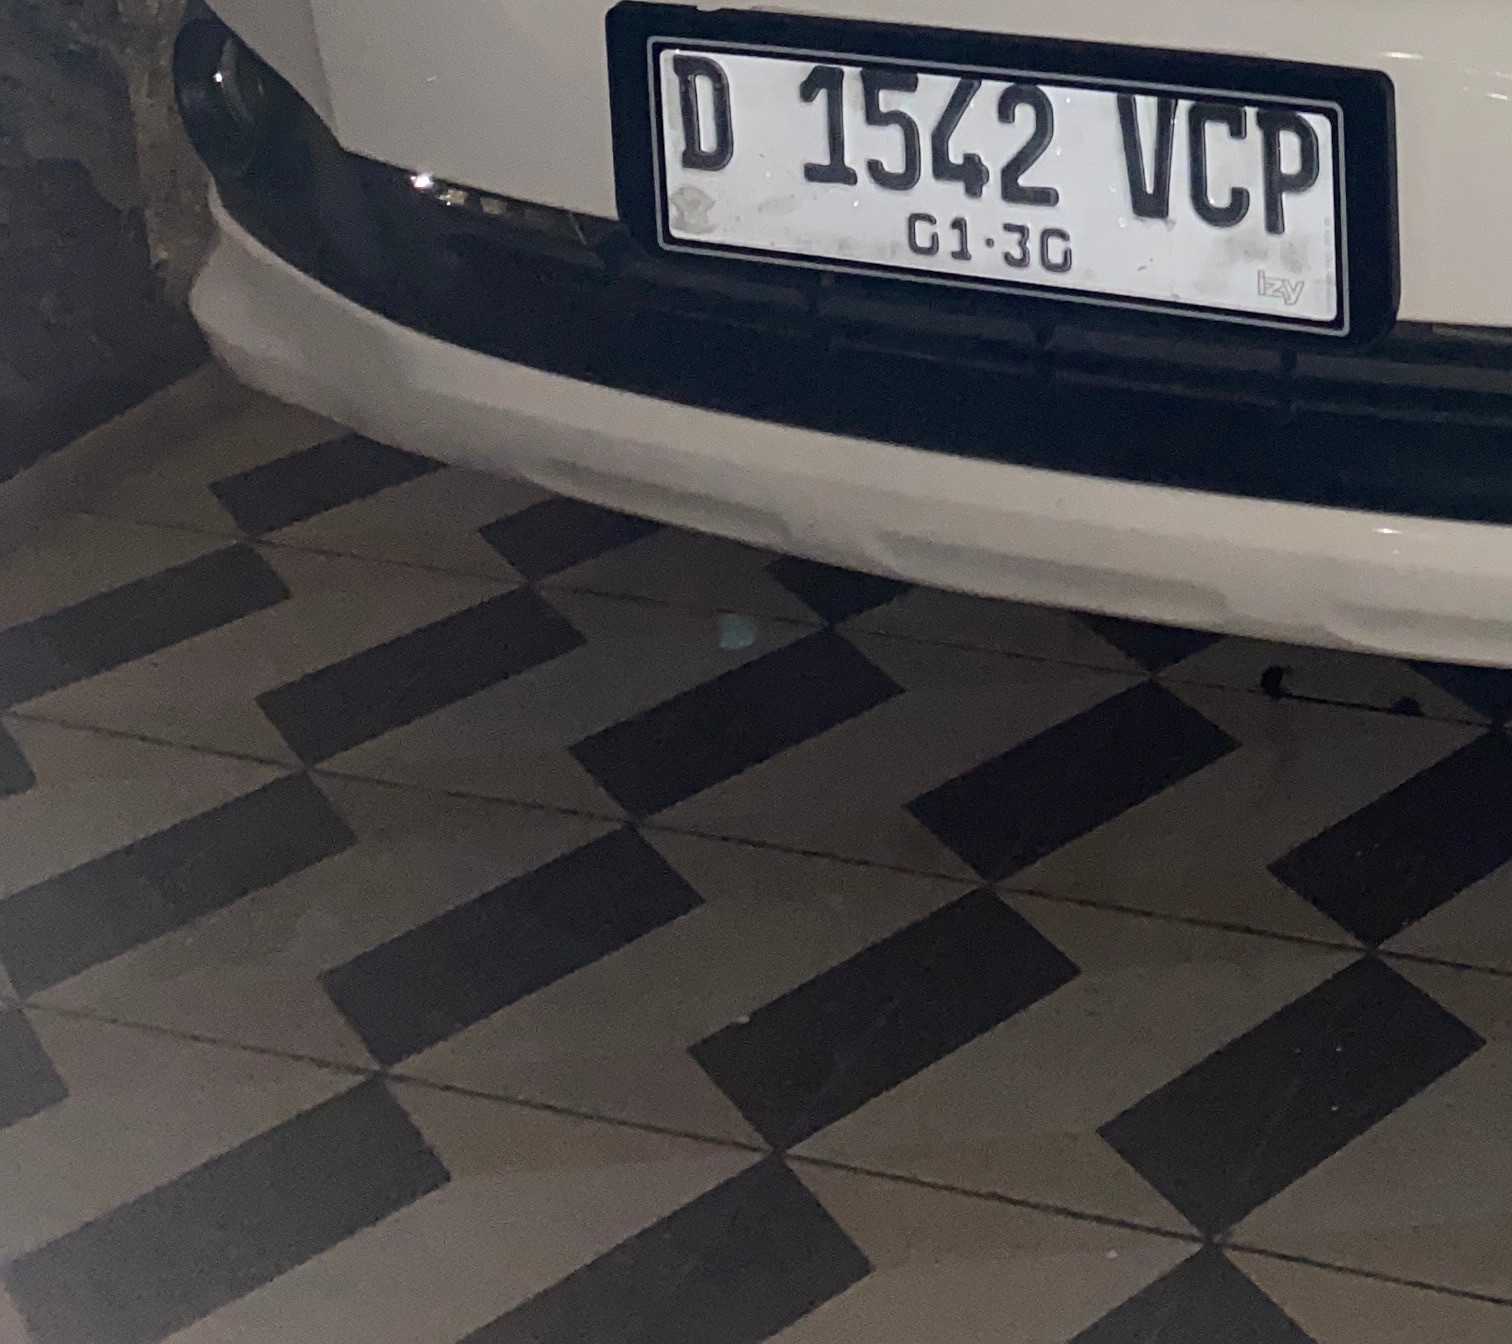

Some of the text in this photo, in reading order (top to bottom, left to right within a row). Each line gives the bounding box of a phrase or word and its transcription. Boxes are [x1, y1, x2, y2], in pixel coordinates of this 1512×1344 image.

[672, 53, 1320, 236] D 1542 VCP
